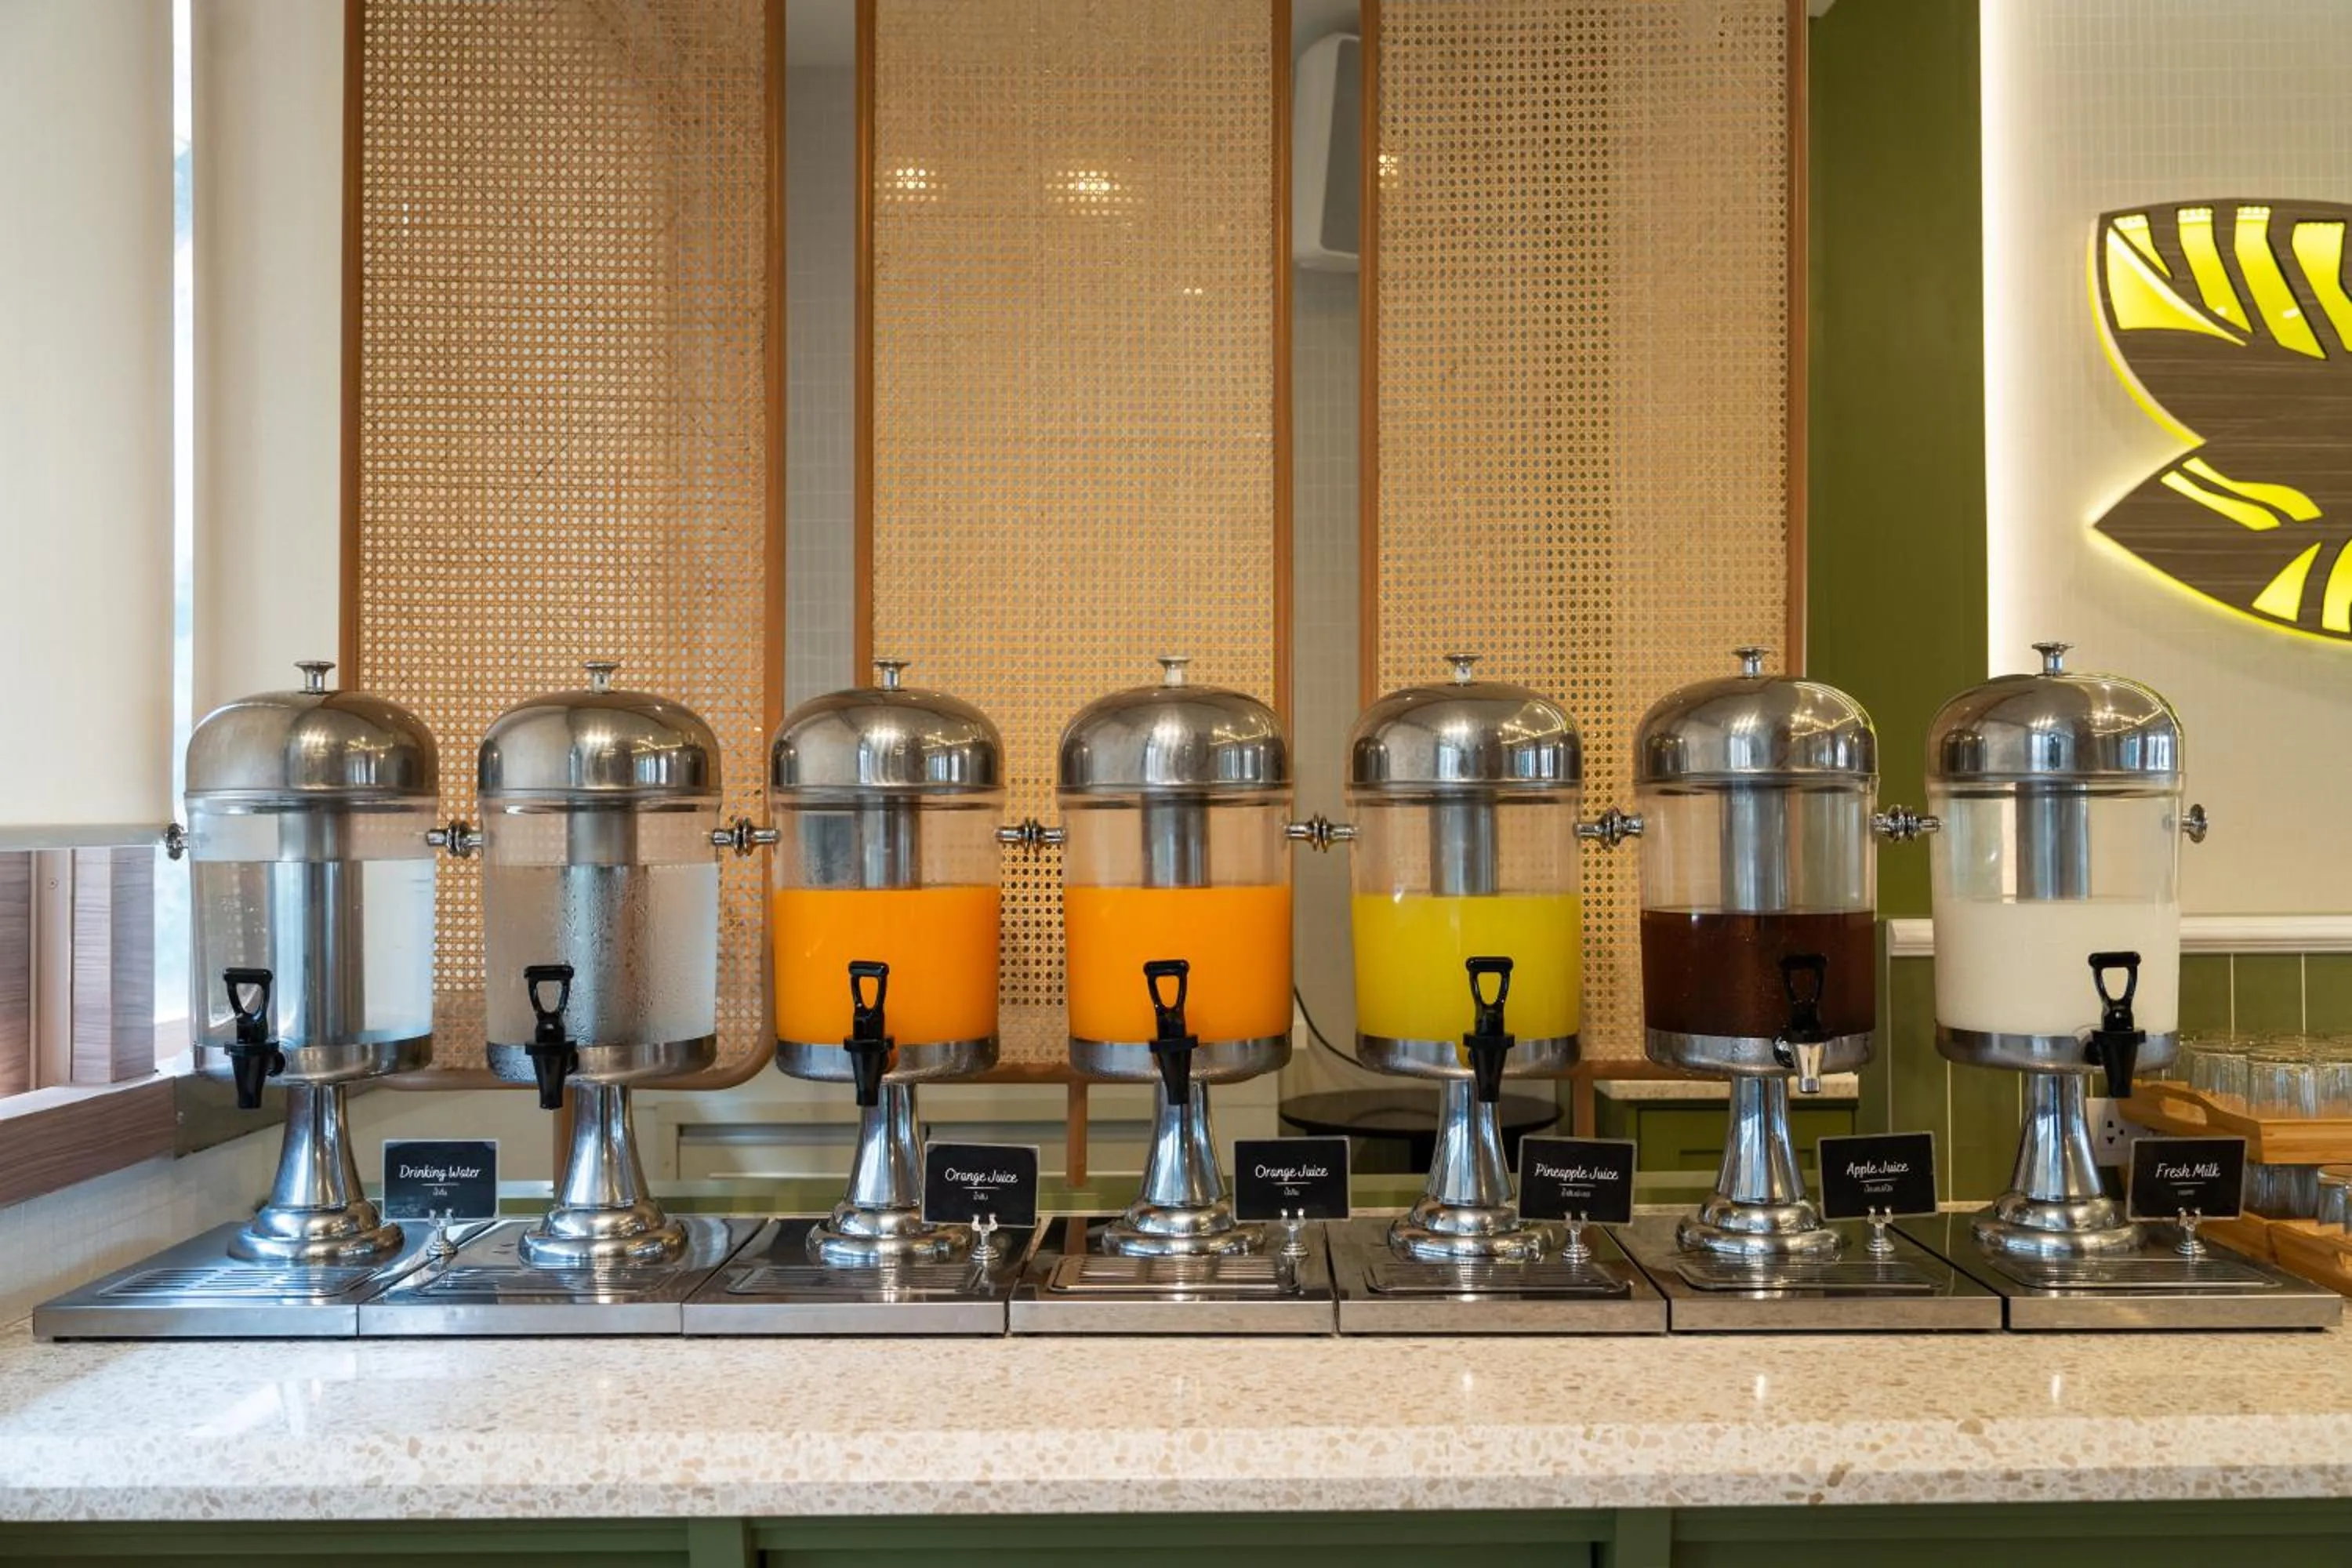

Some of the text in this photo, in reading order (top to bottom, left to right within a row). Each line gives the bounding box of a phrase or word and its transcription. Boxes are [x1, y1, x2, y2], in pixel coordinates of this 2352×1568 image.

[399, 1164, 481, 1182] Drinking Water
[945, 1167, 1018, 1186] Orange Juice
[1254, 1163, 1329, 1181] Orange Juice
[1534, 1163, 1619, 1181] Pineapple Juice
[1846, 1160, 1910, 1178] Apple Juice
[2155, 1162, 2221, 1178] Fresh Milk
